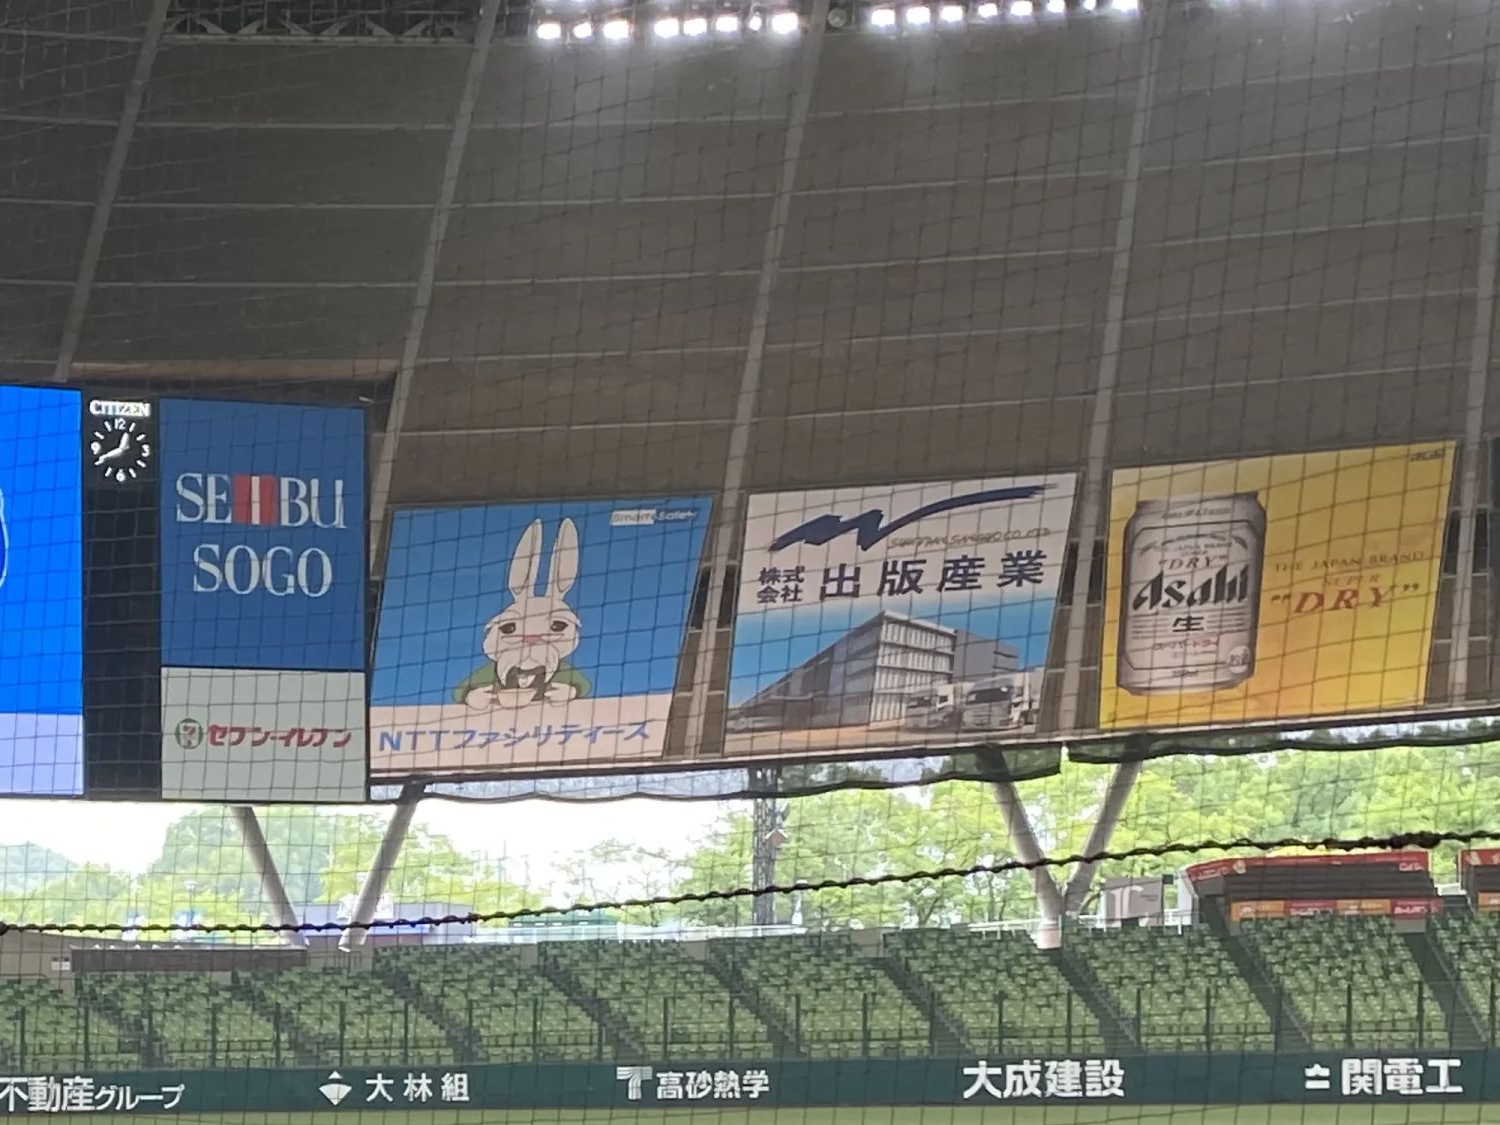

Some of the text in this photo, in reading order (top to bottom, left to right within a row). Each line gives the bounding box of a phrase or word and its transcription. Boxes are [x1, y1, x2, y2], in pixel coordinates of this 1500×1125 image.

[90, 399, 151, 417] CITIZEN
[114, 418, 127, 430] 12
[176, 472, 348, 528] SEIBU
[193, 543, 333, 597] SOGO
[819, 550, 1047, 601] 出版産業
[1132, 564, 1249, 611] Asahi
[1172, 615, 1204, 634] 生
[364, 1071, 470, 1104] 大林組
[656, 1069, 770, 1100] 高砂熱学
[961, 1058, 1125, 1099] 大成建設
[1341, 1057, 1464, 1096] 関電工
